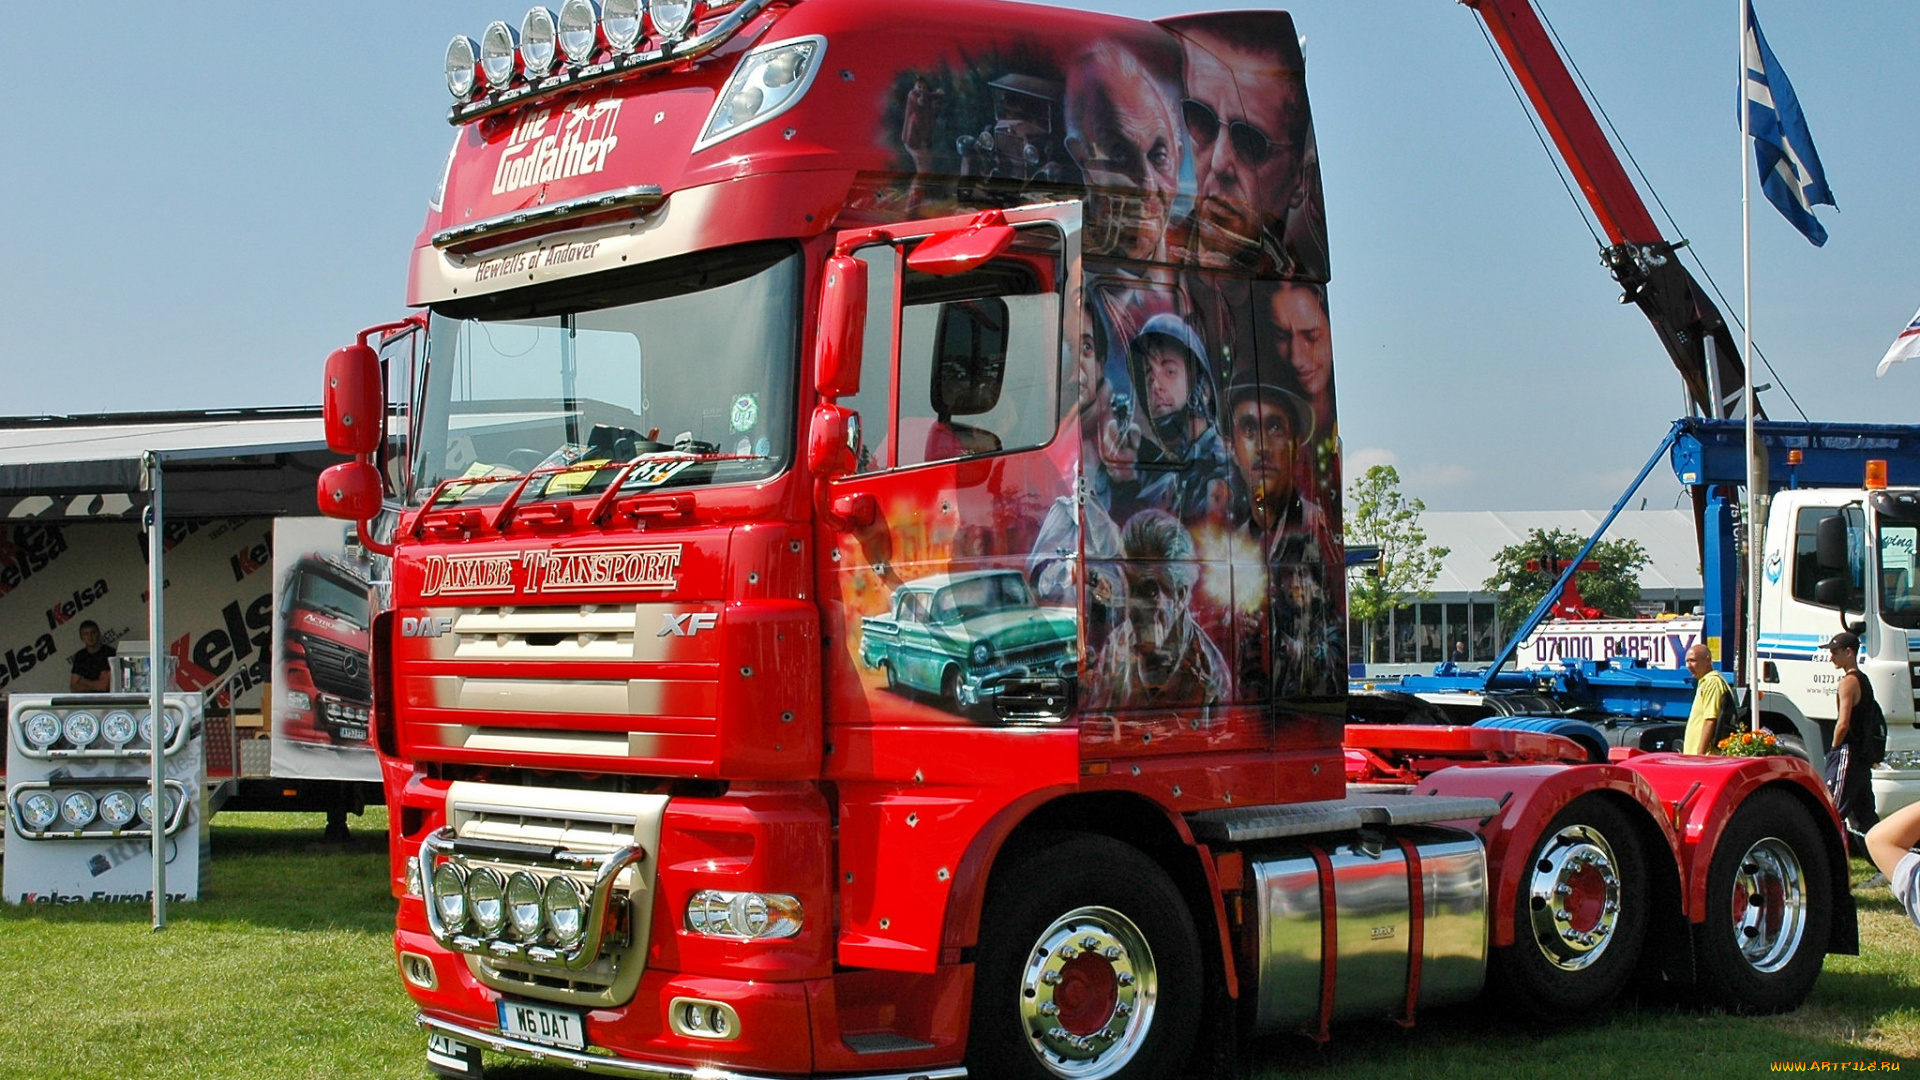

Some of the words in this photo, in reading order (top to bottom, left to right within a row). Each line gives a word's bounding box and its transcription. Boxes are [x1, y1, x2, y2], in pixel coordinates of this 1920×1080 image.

[507, 106, 550, 147] The
[492, 131, 618, 195] Godfather
[528, 246, 546, 270] of
[544, 241, 601, 267] Andover
[421, 552, 519, 597] DANABB
[522, 545, 682, 594] TRANSPORT
[46, 578, 109, 630] Kelsa
[402, 617, 453, 637] DAF
[657, 613, 718, 637] XF
[539, 1011, 569, 1041] DAT
